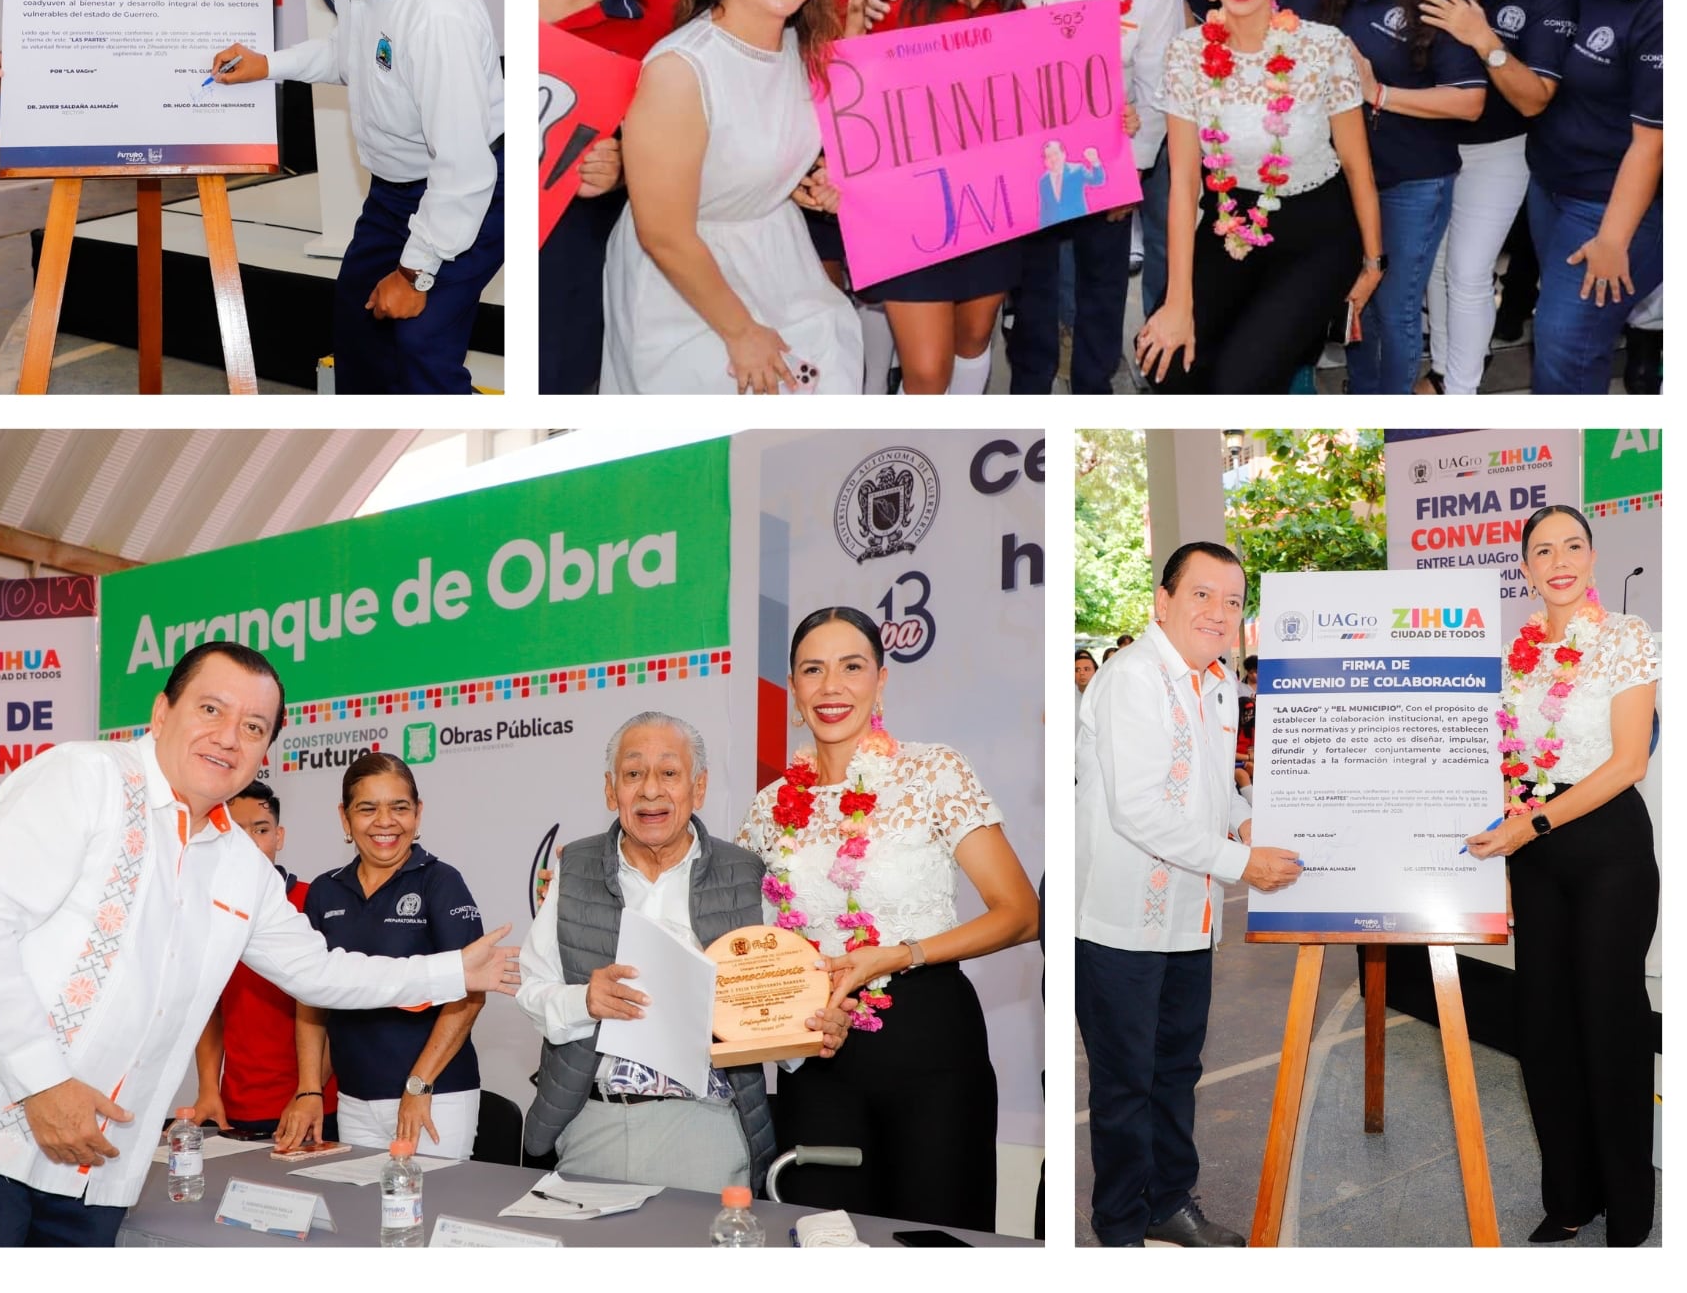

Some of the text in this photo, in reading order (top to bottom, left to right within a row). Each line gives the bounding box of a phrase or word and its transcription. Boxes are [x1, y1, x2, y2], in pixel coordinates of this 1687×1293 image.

[827, 54, 1113, 178] BIENVENIDO
[912, 167, 1014, 253] JAVI
[1438, 455, 1482, 470] UAGro
[1488, 445, 1553, 467] ZIHUA
[1488, 466, 1516, 475] CIUDAD
[1517, 464, 1526, 472] DE
[1527, 461, 1553, 471] TODOS
[837, 451, 936, 550] UNIVERSIDAD AUTÓNOMA DE GUERRERO
[1416, 484, 1547, 521] FIRMA DE
[1411, 520, 1528, 552] CONVEN
[1417, 553, 1519, 570] ENTRE LA UAGro
[126, 585, 380, 675] Arranque
[391, 556, 472, 628] de
[487, 530, 677, 610] Obra
[876, 571, 936, 664] 13
[1318, 613, 1378, 627] UAGro
[1391, 608, 1485, 629] ZIHUA
[1391, 630, 1485, 639] CIUDAD DE TODOS
[17, 672, 27, 680] DE
[29, 671, 61, 679] TODOS
[1342, 660, 1410, 671] FIRMA DE
[1272, 674, 1486, 689] CONVENIO DE COLABORACIÓN
[7, 700, 53, 732] DE
[1330, 715, 1385, 723] colaboración
[1388, 715, 1444, 723] institucional,
[1462, 716, 1488, 724] apego
[1435, 705, 1475, 713] propósito
[283, 727, 389, 750] CONSTRUYENDO
[440, 717, 574, 746] Obras Públicas
[1272, 757, 1316, 765] orientadas
[1393, 757, 1426, 765] integral
[1271, 768, 1310, 776] continua.
[715, 966, 805, 987] Reconocimiento
